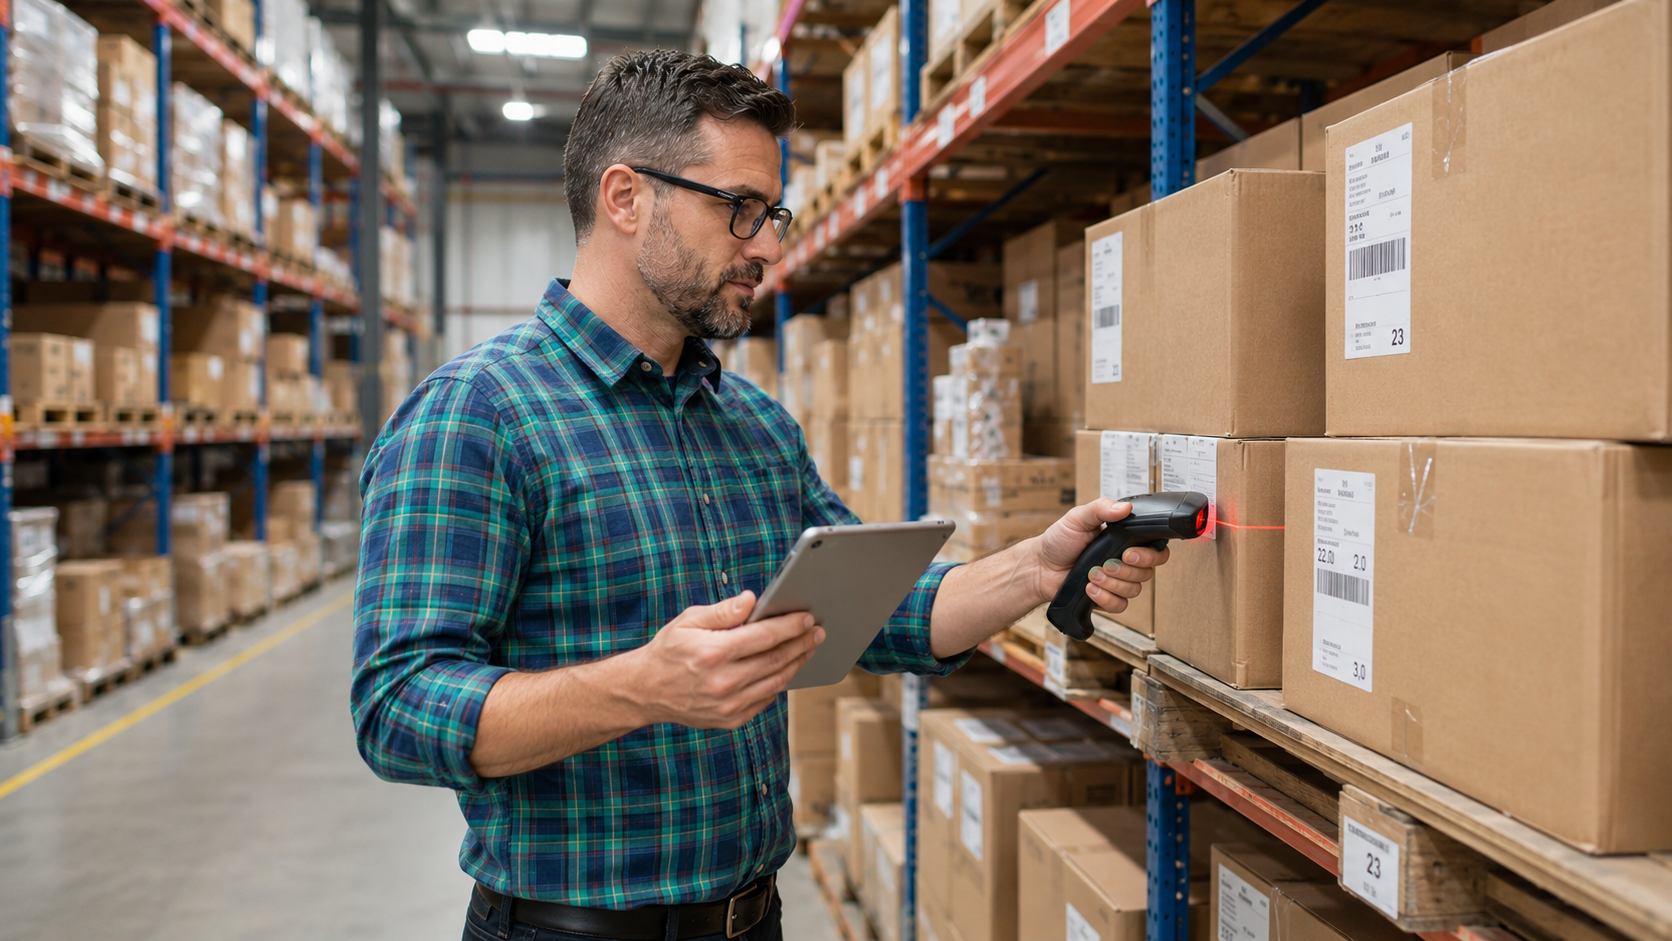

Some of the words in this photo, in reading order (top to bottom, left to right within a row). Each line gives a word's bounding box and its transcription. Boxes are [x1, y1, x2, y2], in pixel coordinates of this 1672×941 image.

[1391, 328, 1404, 346] 23
[1353, 553, 1366, 571] 2.0
[1366, 852, 1381, 879] 23
